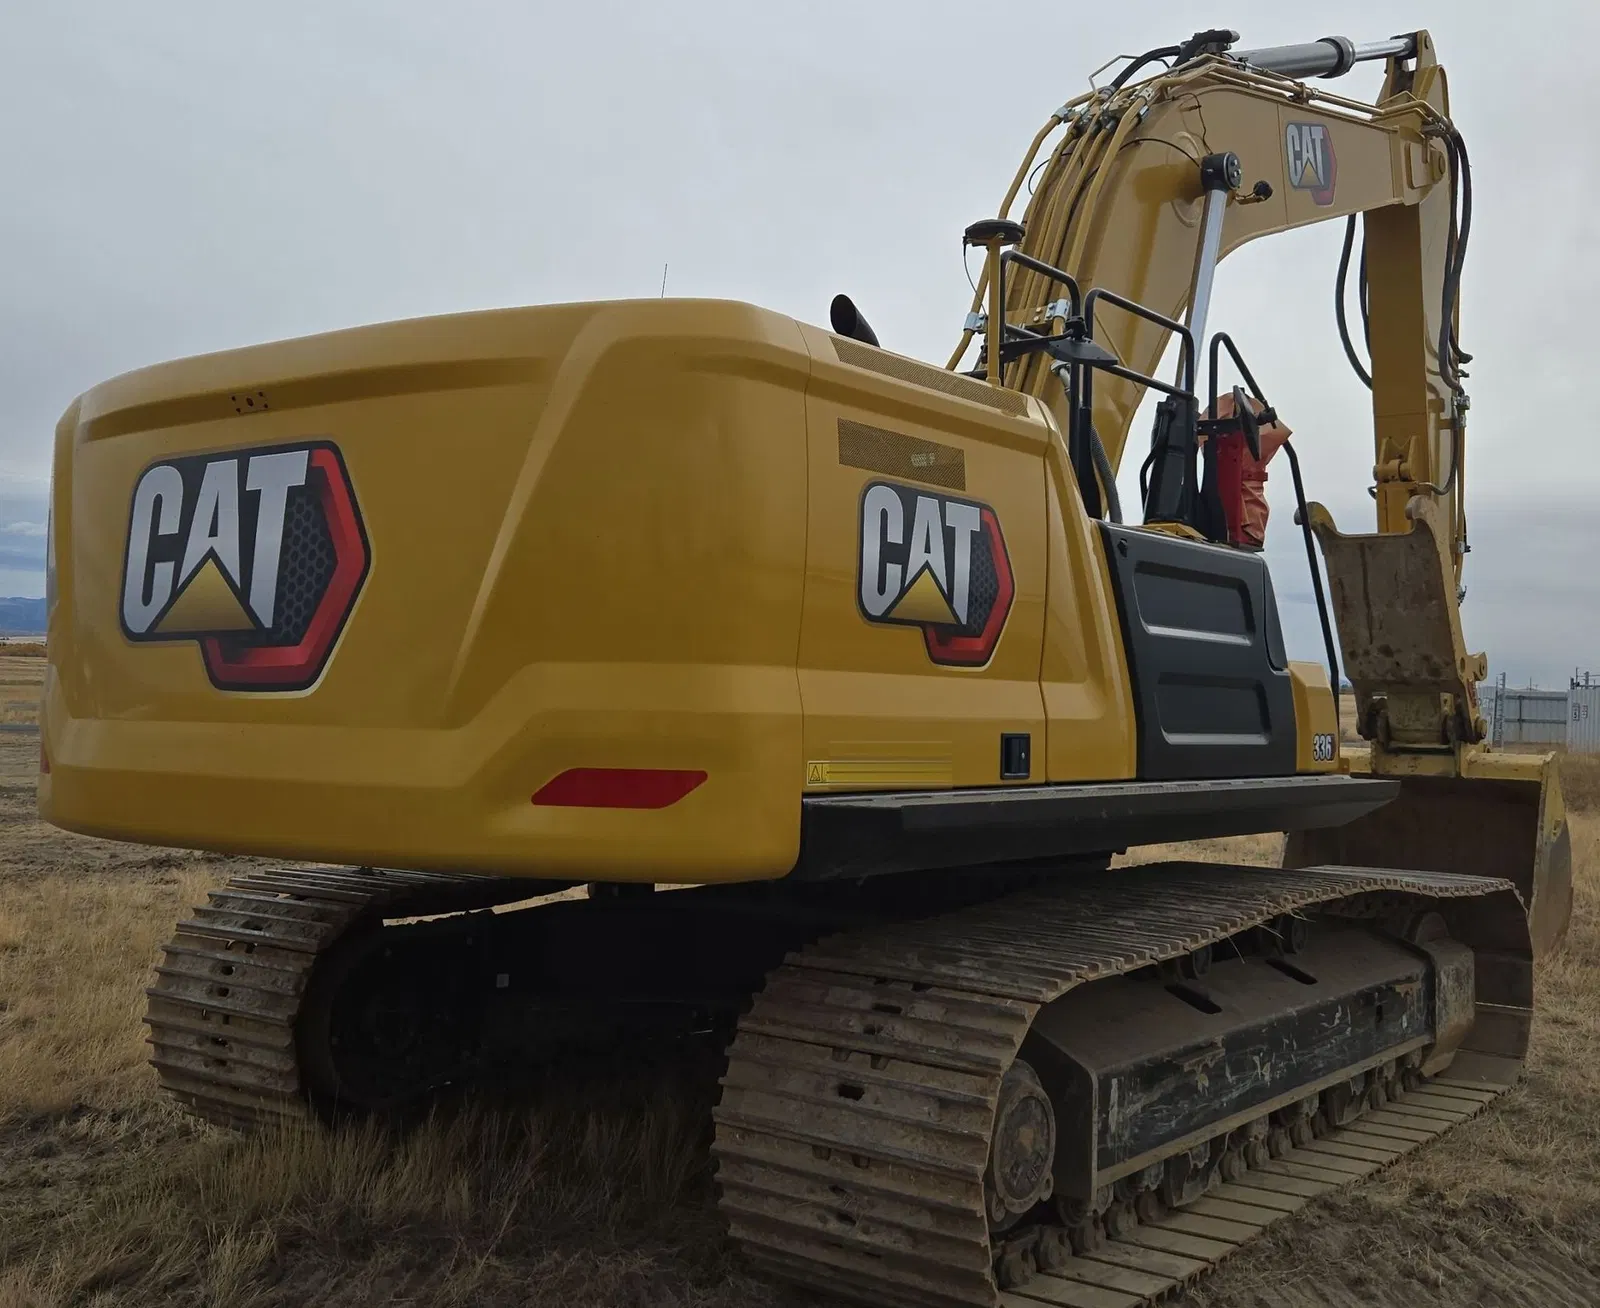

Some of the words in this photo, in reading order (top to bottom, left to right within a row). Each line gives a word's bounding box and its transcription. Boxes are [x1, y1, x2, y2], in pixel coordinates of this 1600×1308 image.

[1286, 124, 1323, 186] CAT
[123, 450, 309, 633] CAT
[861, 485, 980, 625] CAT
[1313, 734, 1332, 760] 336
